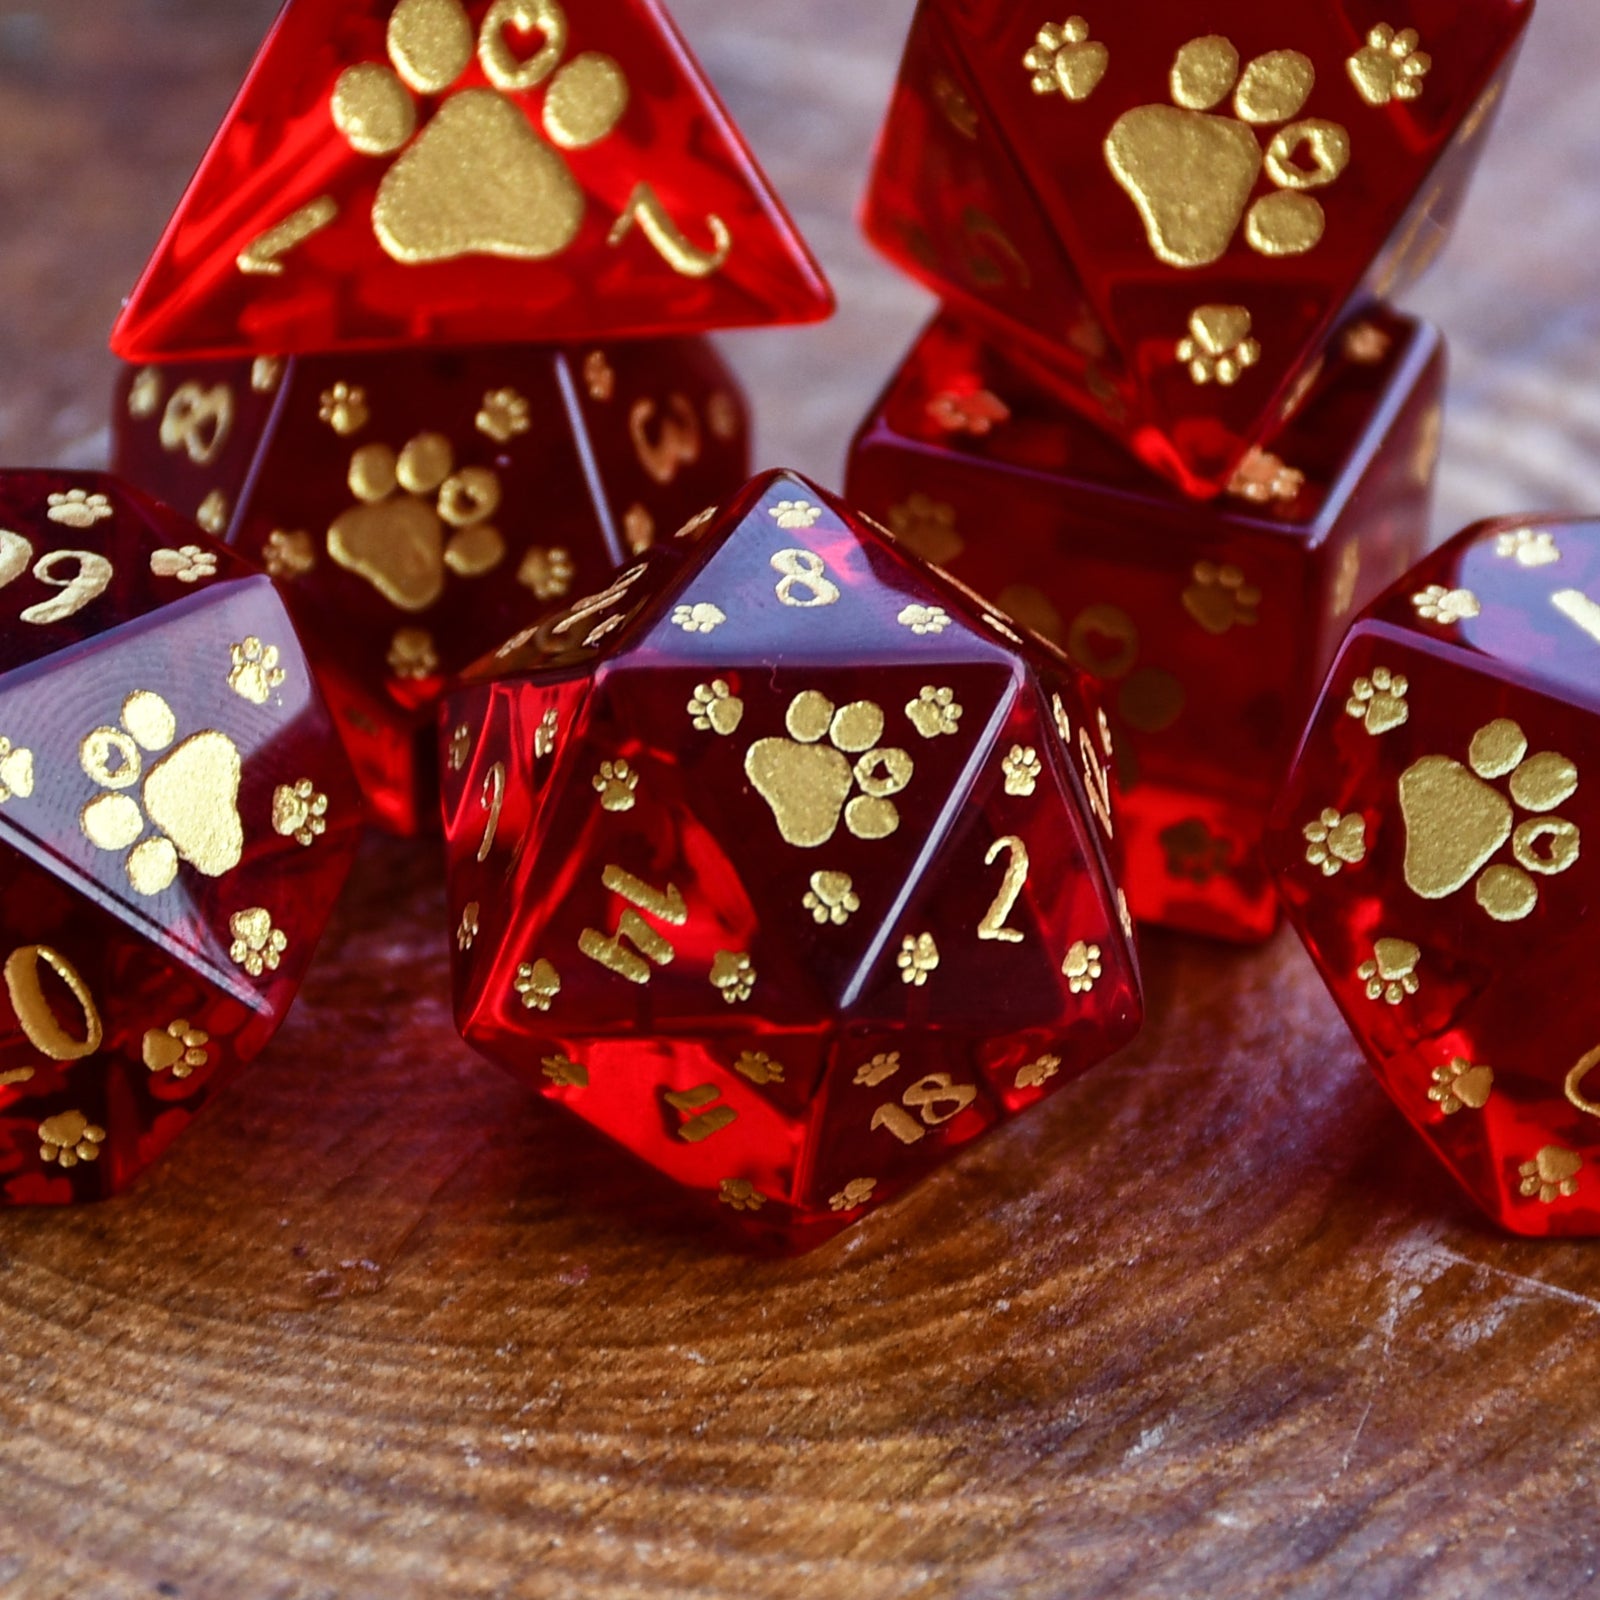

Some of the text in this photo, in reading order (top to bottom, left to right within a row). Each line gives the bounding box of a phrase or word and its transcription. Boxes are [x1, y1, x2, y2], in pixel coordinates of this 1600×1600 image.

[770, 548, 840, 607] 8
[978, 835, 1029, 943] 2
[870, 1073, 978, 1145] 18
